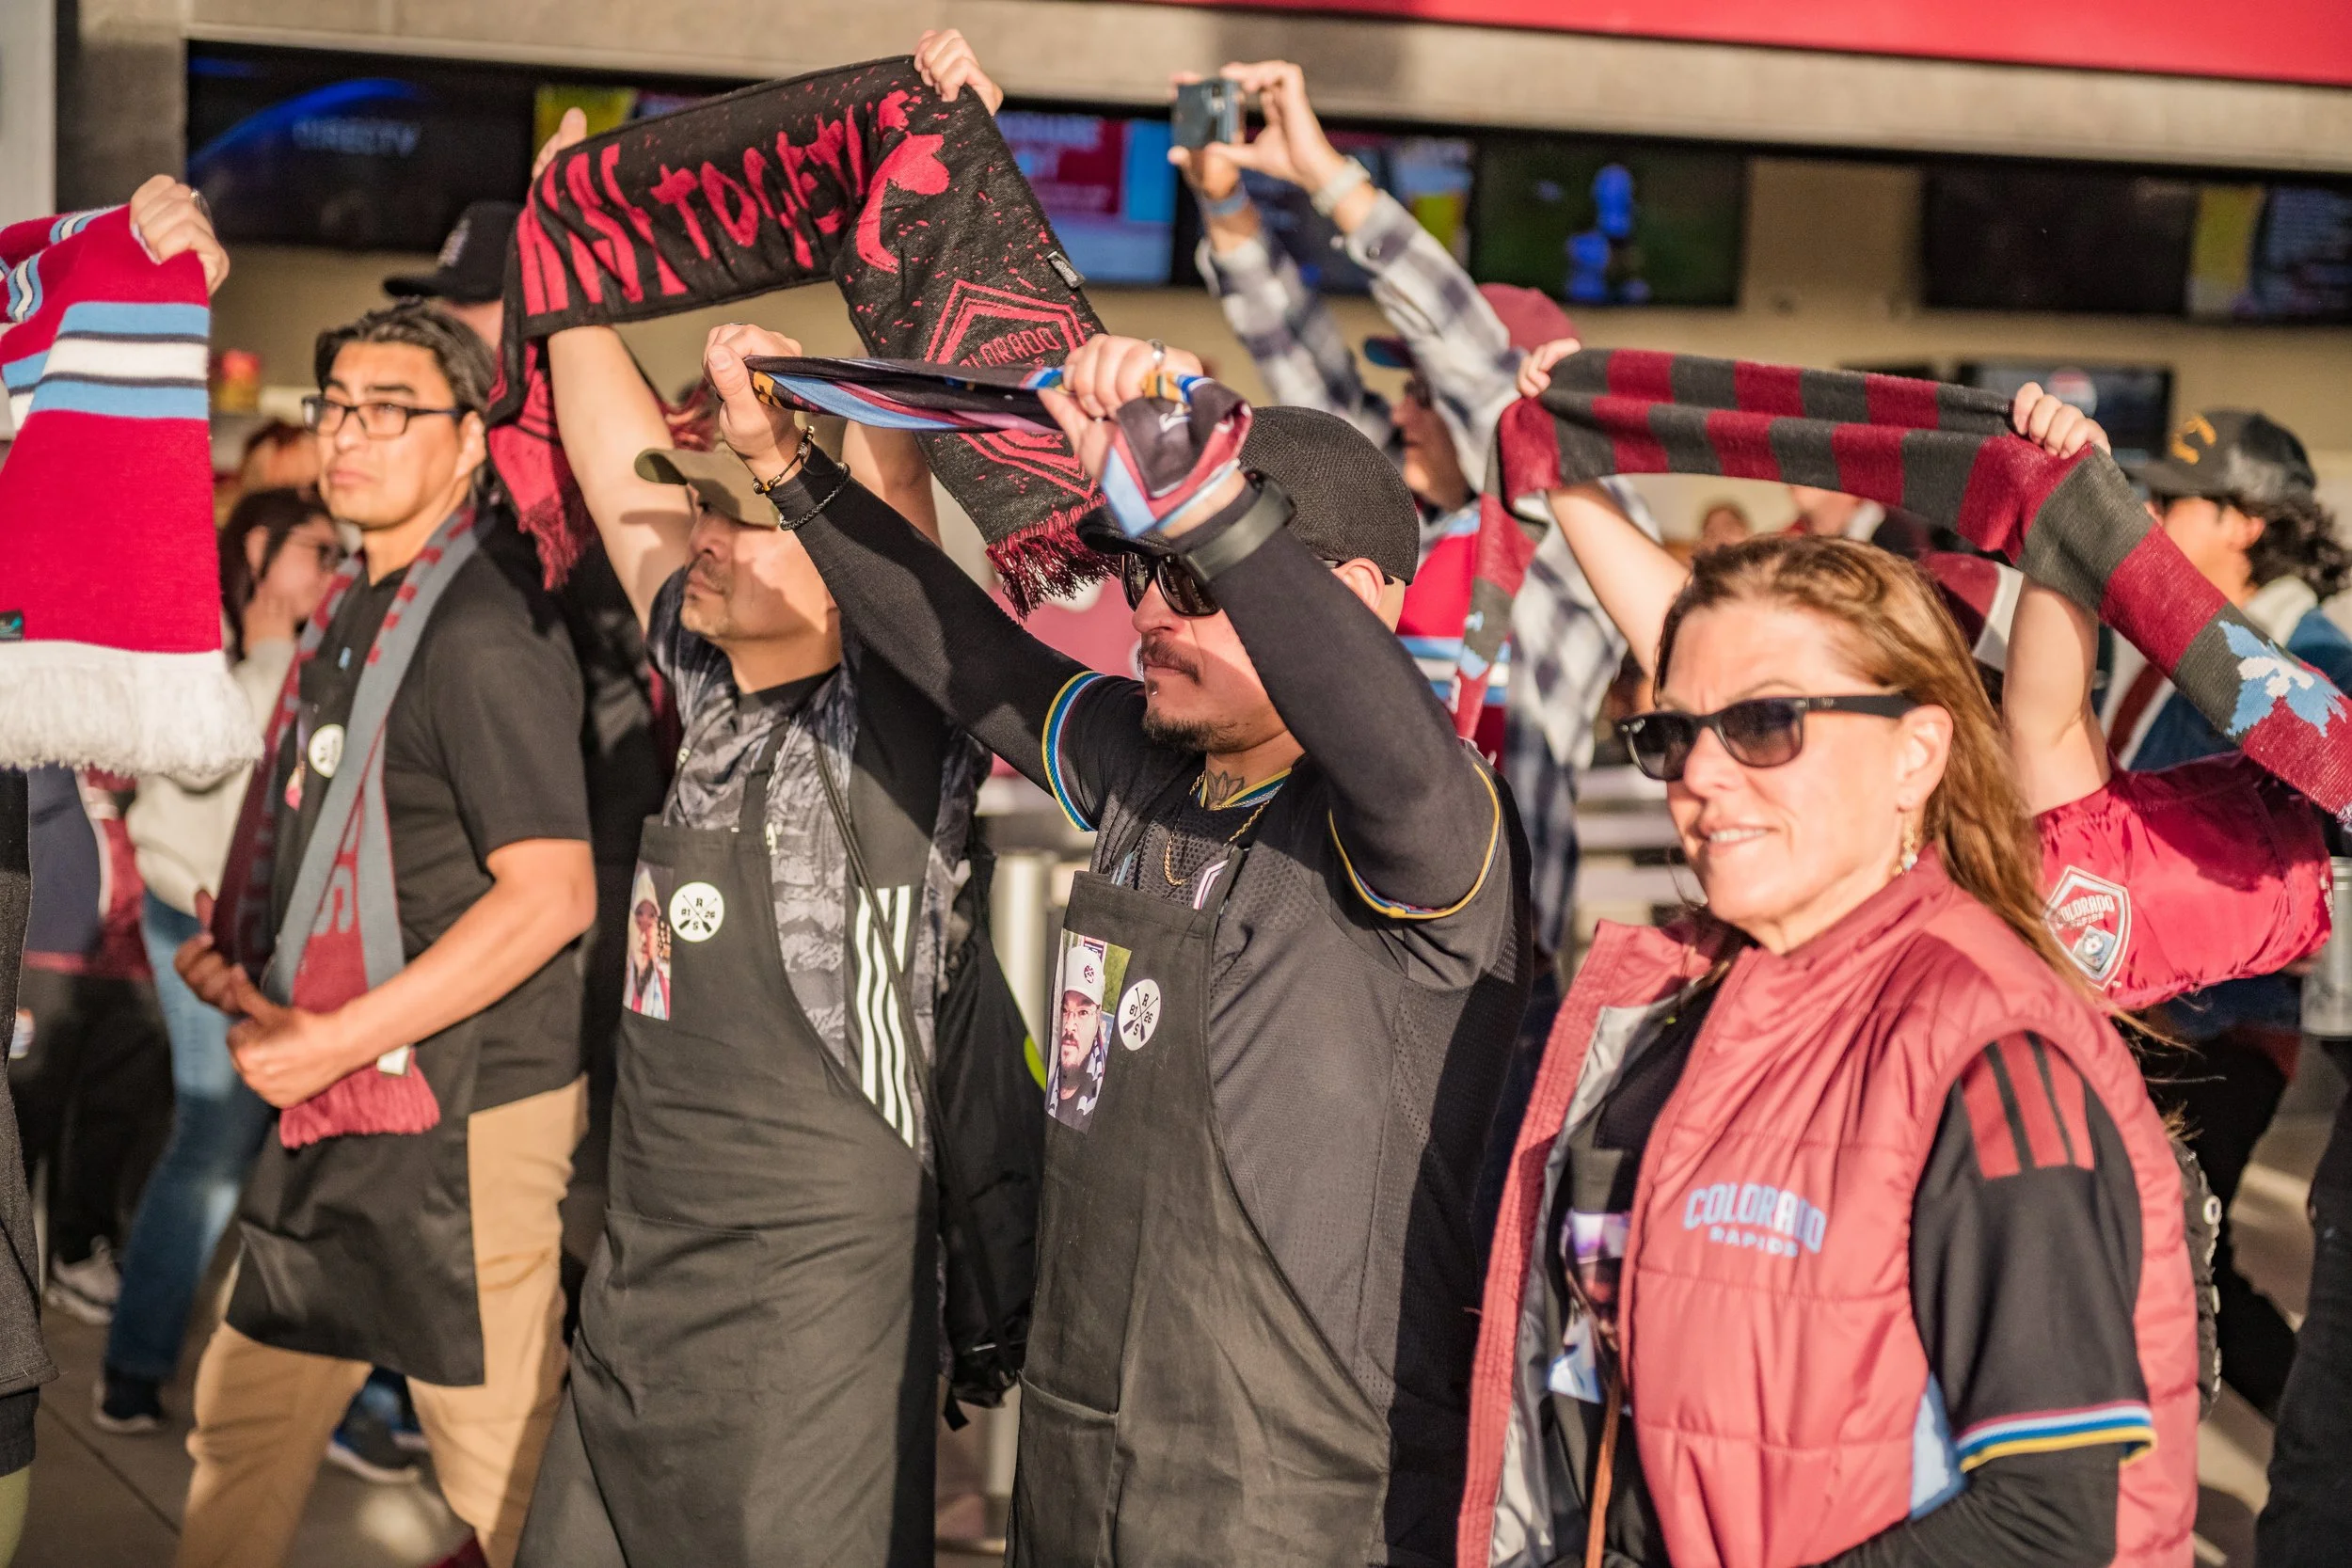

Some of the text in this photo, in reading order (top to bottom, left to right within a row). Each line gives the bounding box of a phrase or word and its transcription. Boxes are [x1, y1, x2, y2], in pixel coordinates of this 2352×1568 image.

[1142, 993, 1149, 1006] R
[1129, 1004, 1153, 1023] 81 26
[1133, 1023, 1139, 1036] S
[1709, 1226, 1798, 1258] RAPIDS
